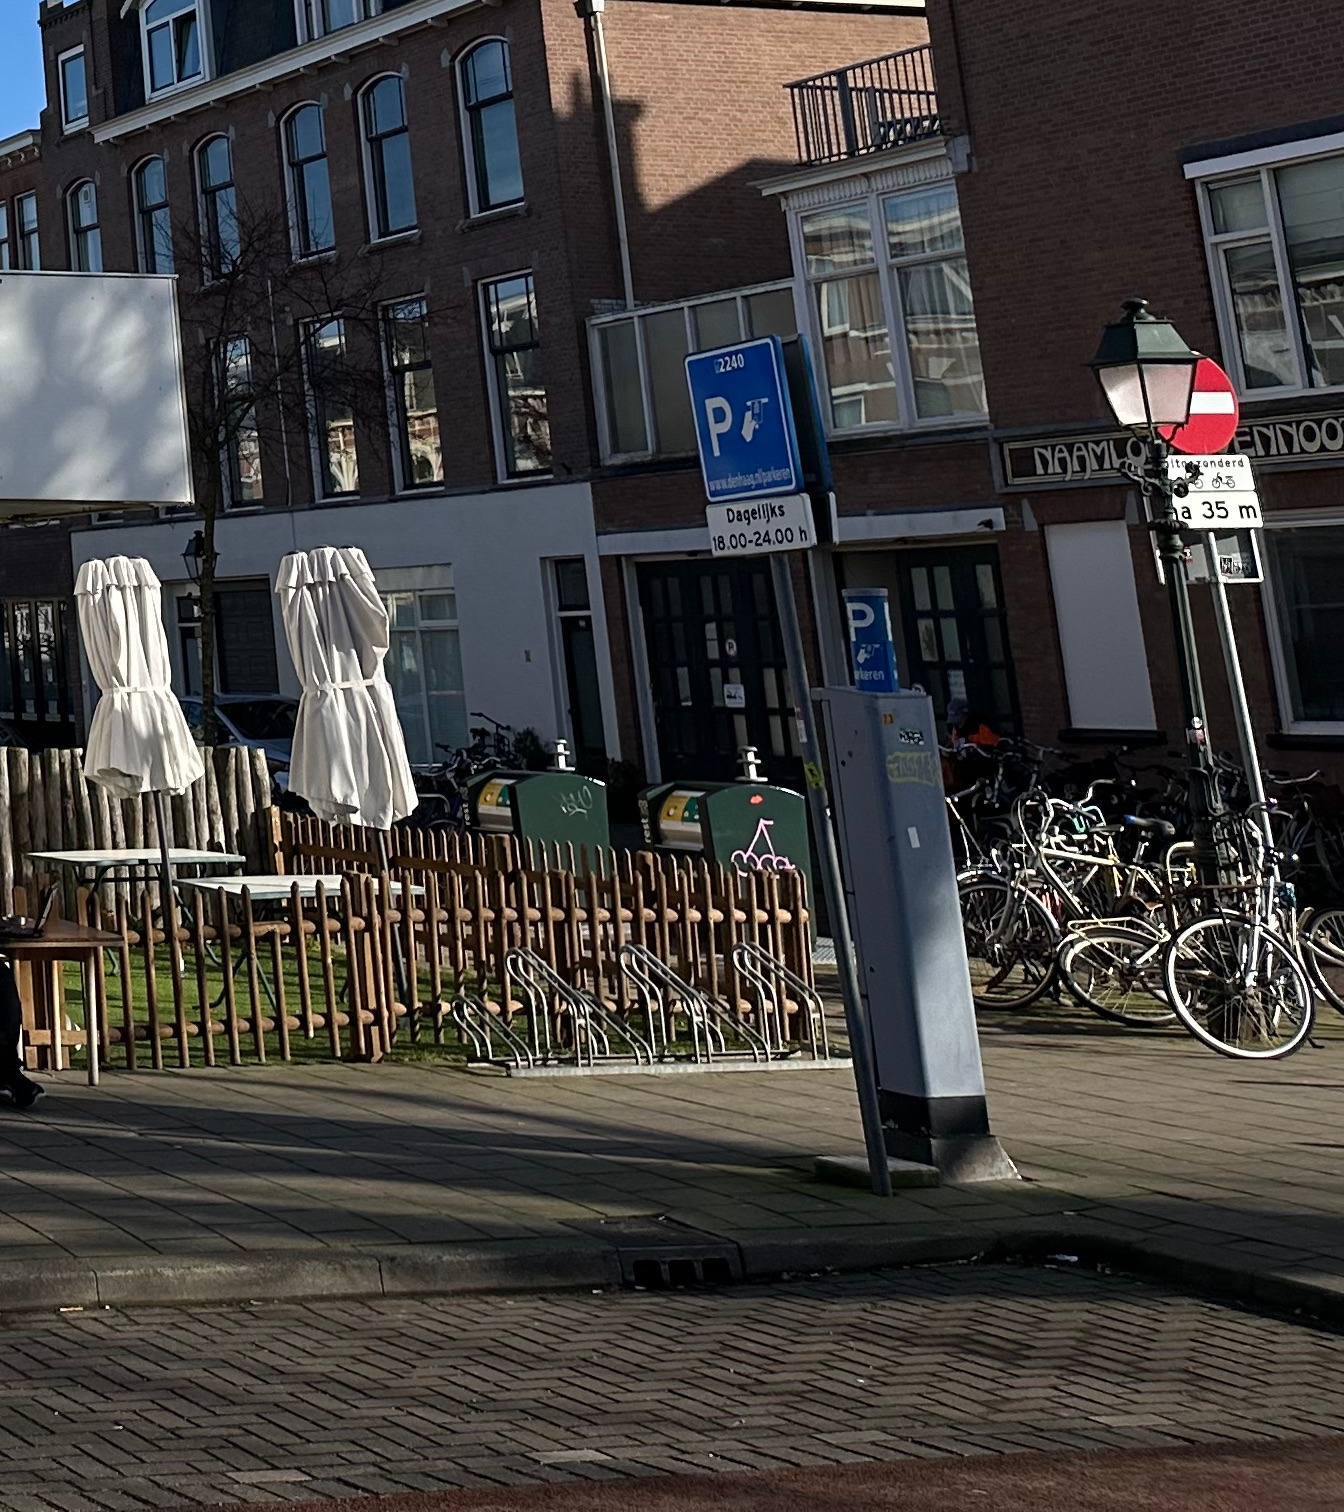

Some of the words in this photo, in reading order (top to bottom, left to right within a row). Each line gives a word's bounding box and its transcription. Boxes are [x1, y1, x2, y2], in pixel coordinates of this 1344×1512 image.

[717, 353, 745, 373] 2240
[704, 396, 733, 457] P
[726, 503, 786, 526] Dagelijks
[1201, 501, 1229, 519] 35
[1240, 505, 1257, 518] m
[713, 526, 794, 551] 18.00-24.00
[799, 526, 808, 542] h
